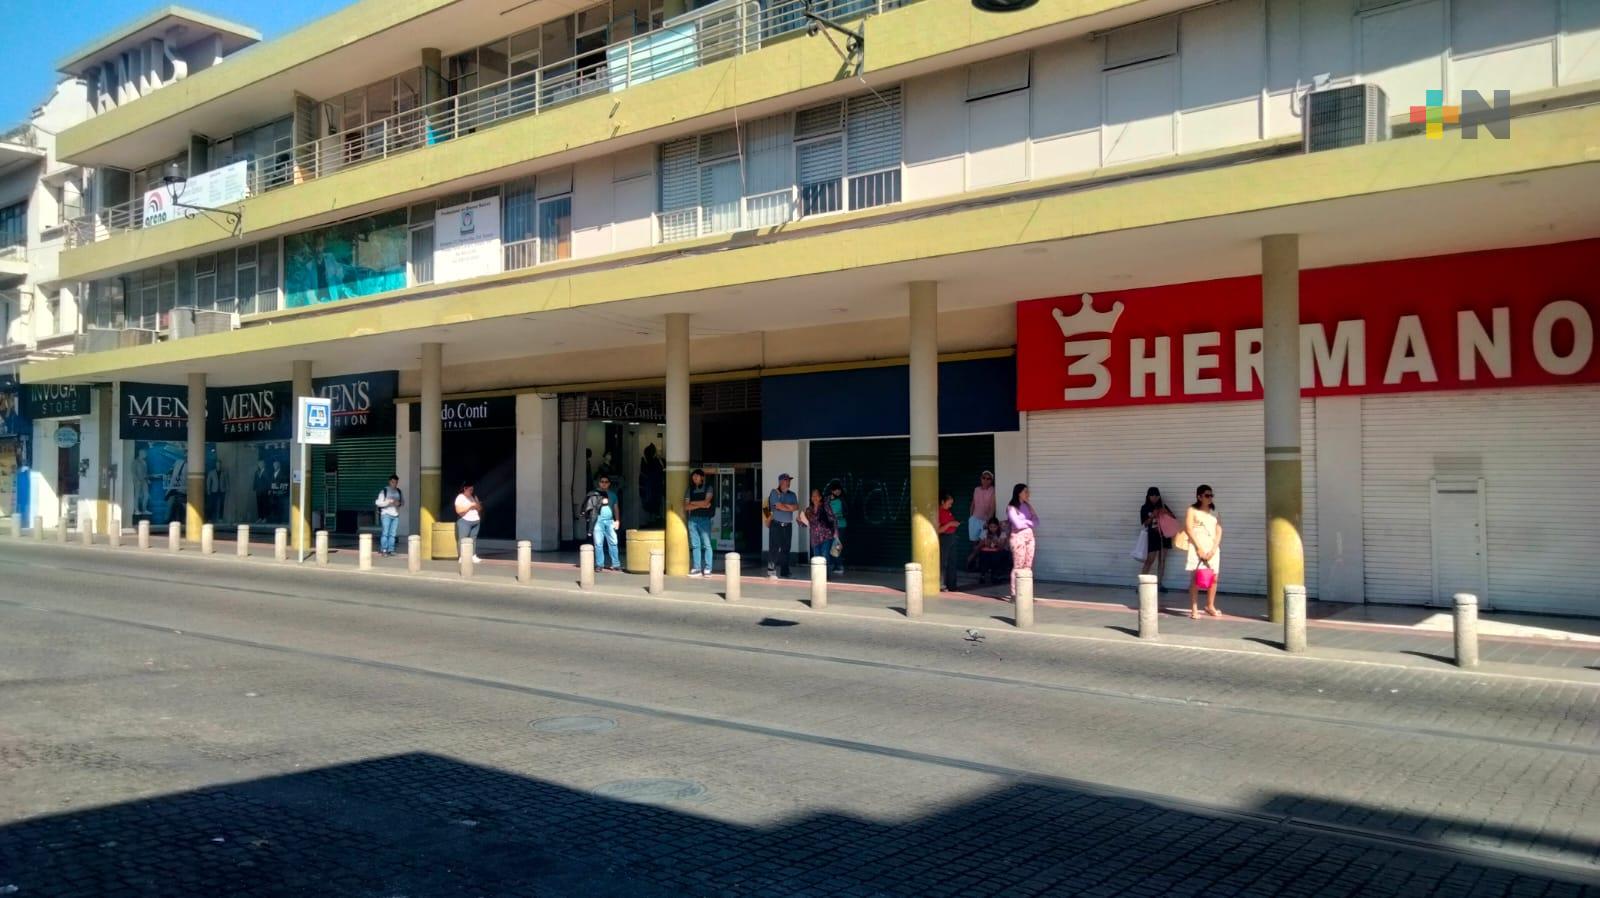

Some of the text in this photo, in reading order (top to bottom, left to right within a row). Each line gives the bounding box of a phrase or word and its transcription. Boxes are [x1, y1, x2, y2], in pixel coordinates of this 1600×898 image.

[1063, 337, 1113, 401] 3
[42, 399, 77, 415] STORE
[440, 400, 488, 420] do Conti
[590, 399, 622, 417] Aldo
[223, 420, 273, 433] FASHION
[334, 414, 368, 427] HION
[443, 420, 473, 429] ITALIA
